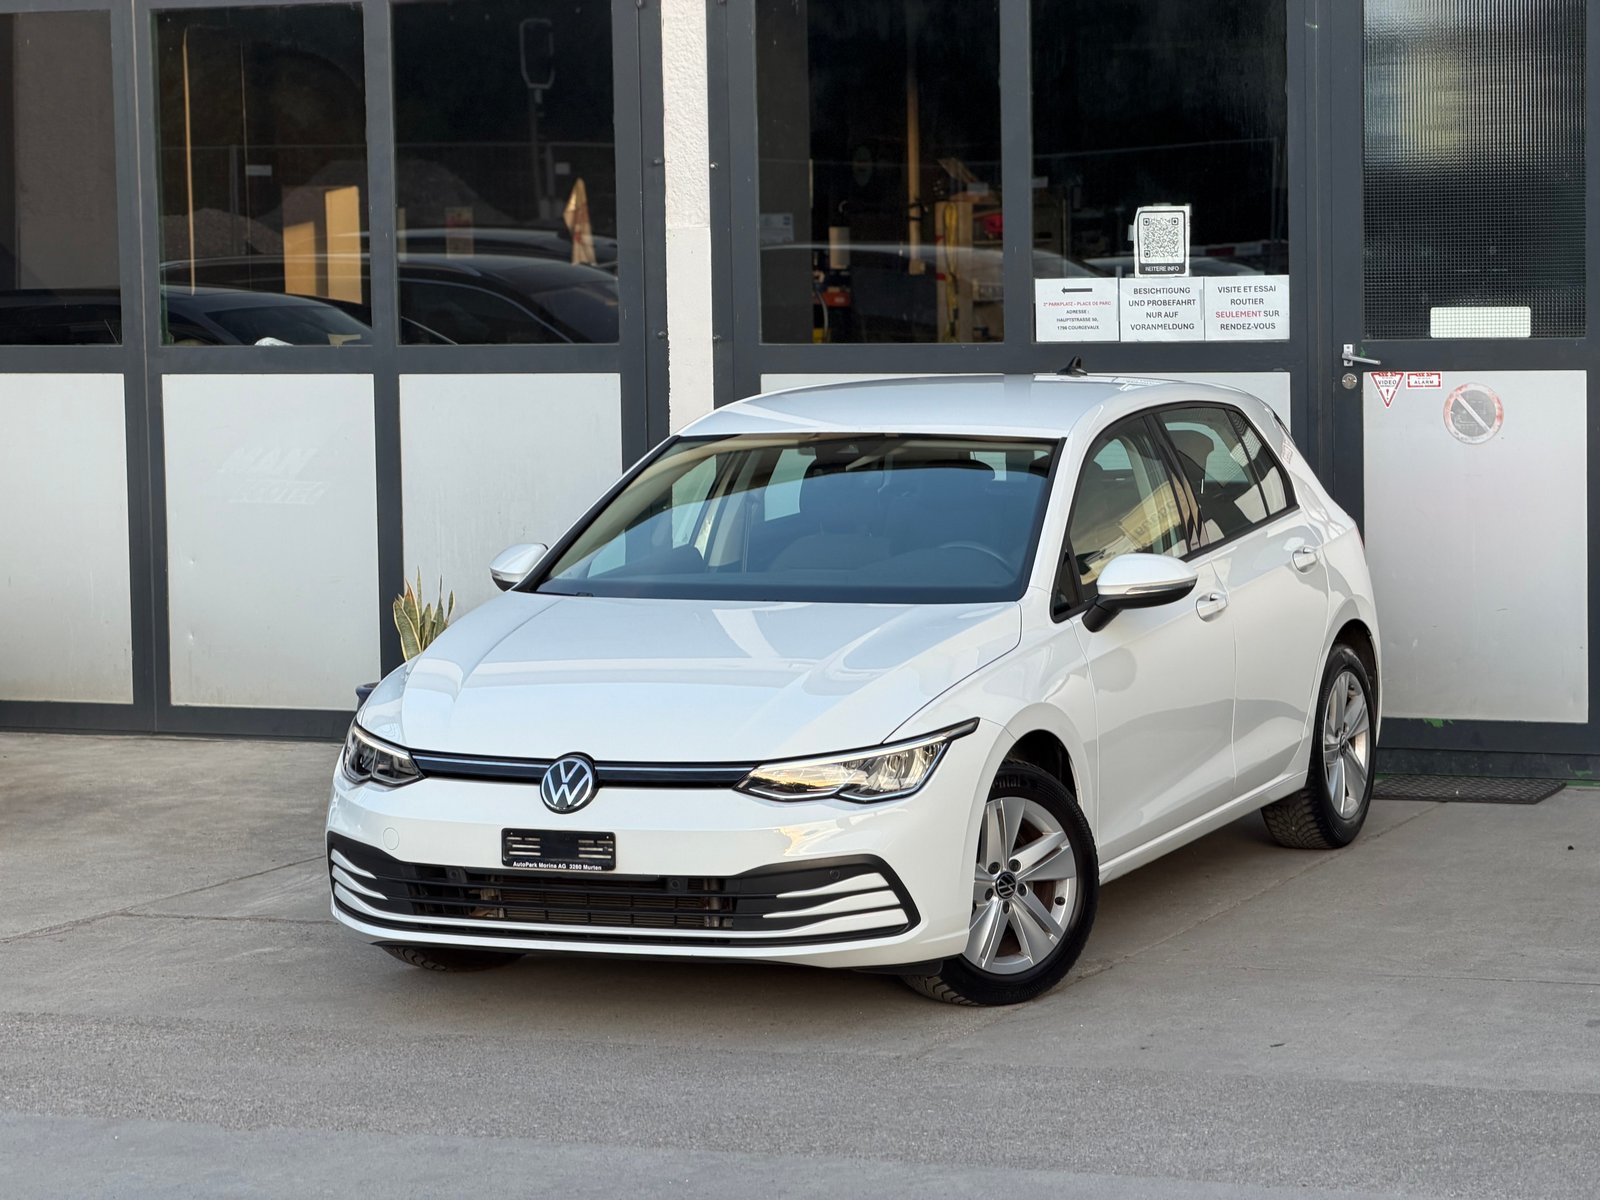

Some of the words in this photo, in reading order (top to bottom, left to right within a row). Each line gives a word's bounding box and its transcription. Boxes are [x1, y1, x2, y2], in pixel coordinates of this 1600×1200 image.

[1133, 287, 1191, 295] BESICHTIGUNG
[1146, 298, 1196, 306] PROBEFAHRT
[1215, 310, 1262, 318] SEULEMENT
[1130, 323, 1195, 331] VORANMELDUNG
[1220, 322, 1276, 330] RENDEZ-VOUS
